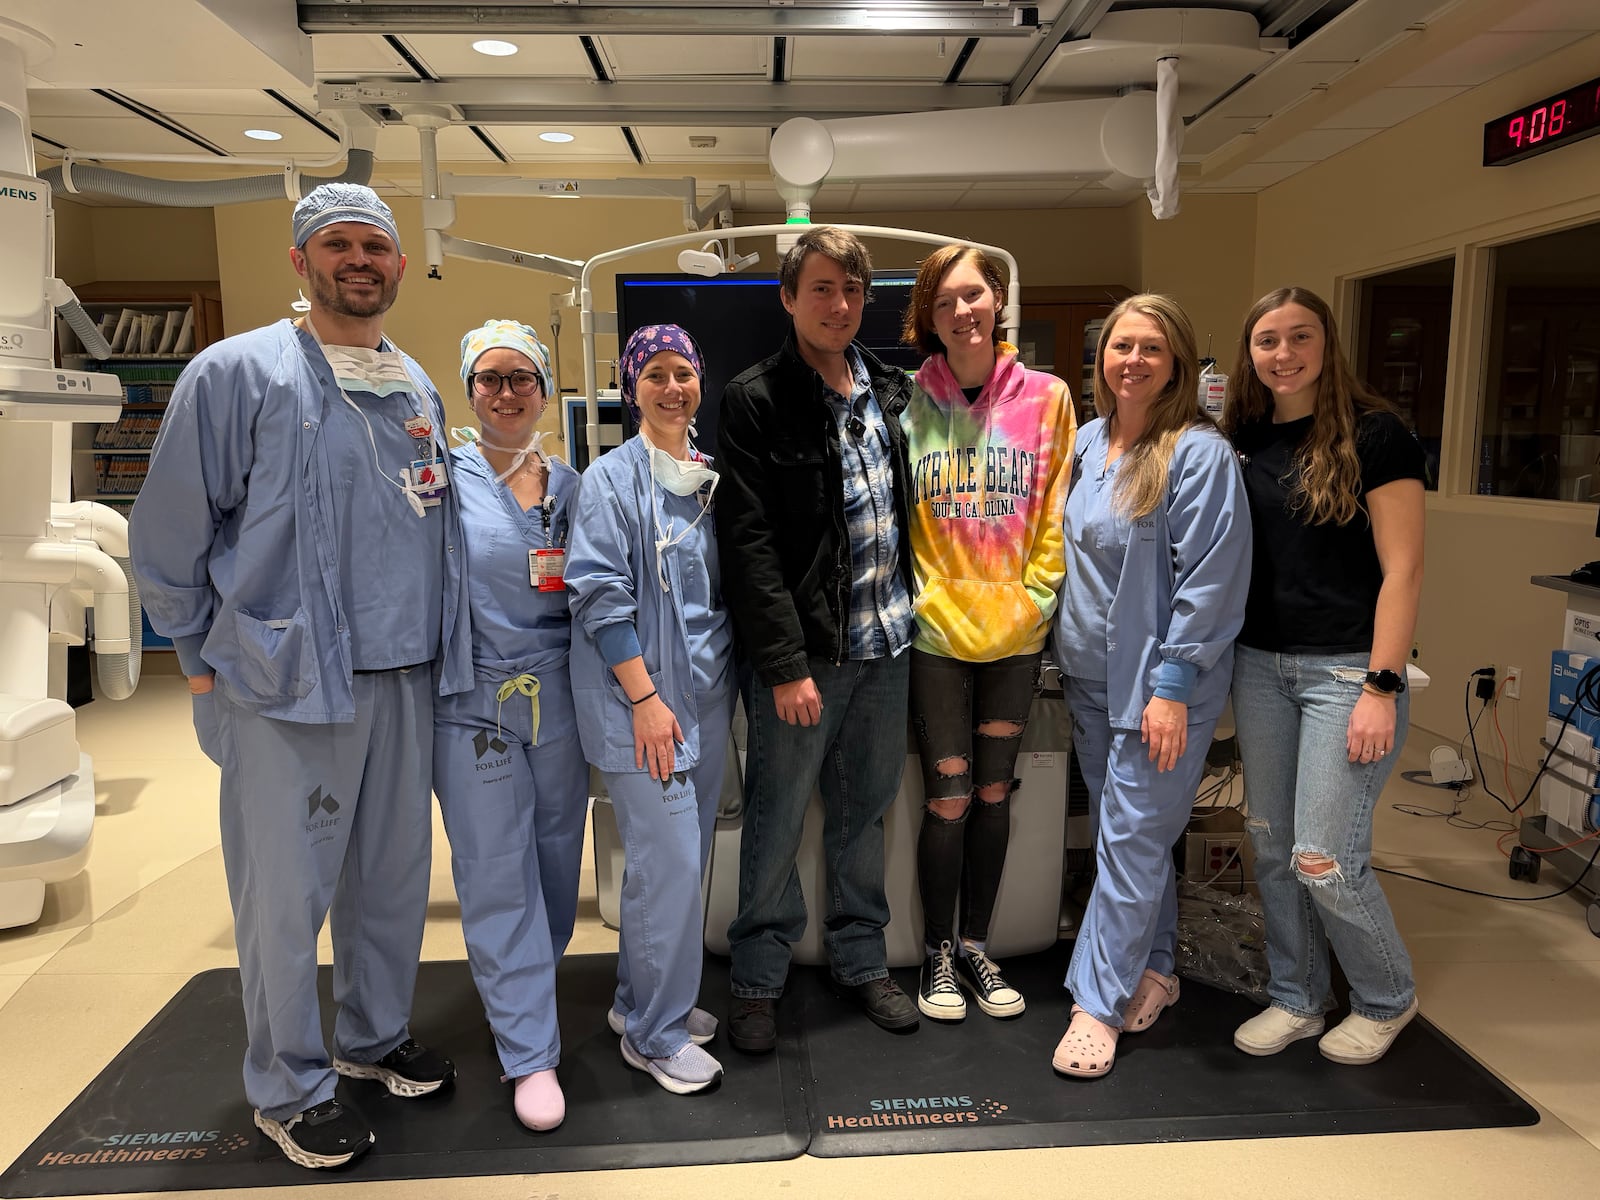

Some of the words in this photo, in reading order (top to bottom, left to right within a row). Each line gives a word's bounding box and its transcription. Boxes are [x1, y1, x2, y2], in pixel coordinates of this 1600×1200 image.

[931, 502, 962, 518] SOUH
[965, 498, 1016, 518] CAOLINA
[1137, 520, 1155, 528] FOR
[475, 761, 494, 772] FOR
[662, 793, 680, 803] FOR
[870, 1096, 974, 1111] SIEMENS
[827, 1111, 979, 1129] Healthineers
[104, 1130, 220, 1147] SIEMENS
[37, 1147, 209, 1167] Healthineers
